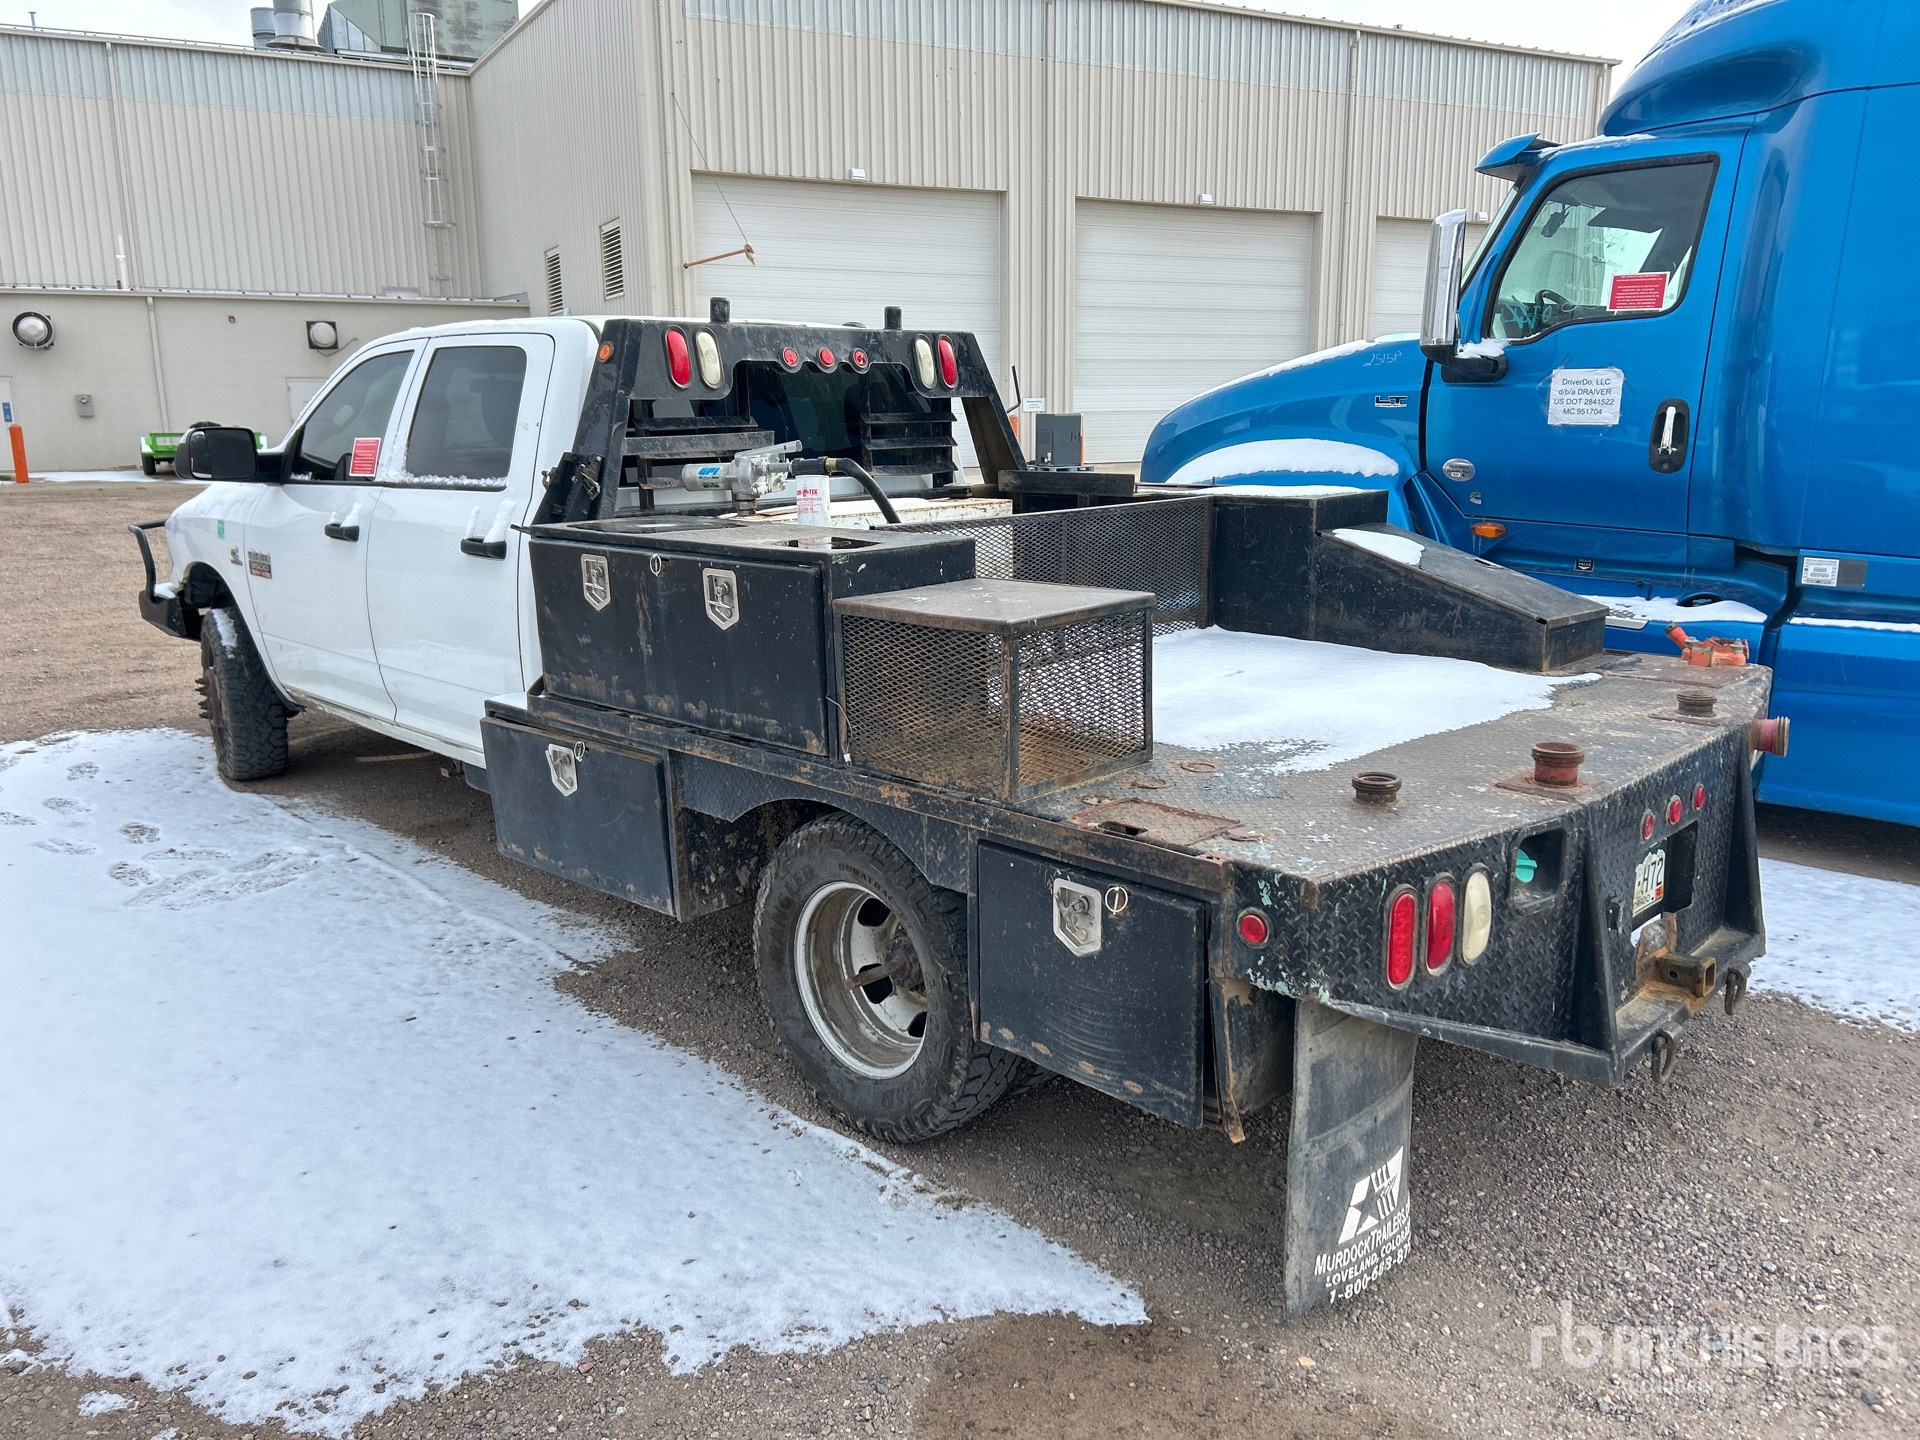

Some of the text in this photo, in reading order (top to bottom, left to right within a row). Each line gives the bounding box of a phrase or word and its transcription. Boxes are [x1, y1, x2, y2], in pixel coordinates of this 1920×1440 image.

[1562, 378, 1611, 386] DriverDo, LLC
[1558, 388, 1612, 396] d/b/a DRAIVER
[1584, 398, 1615, 406] 2841522
[1562, 407, 1603, 416] MC 951704
[698, 467, 721, 476] GPI
